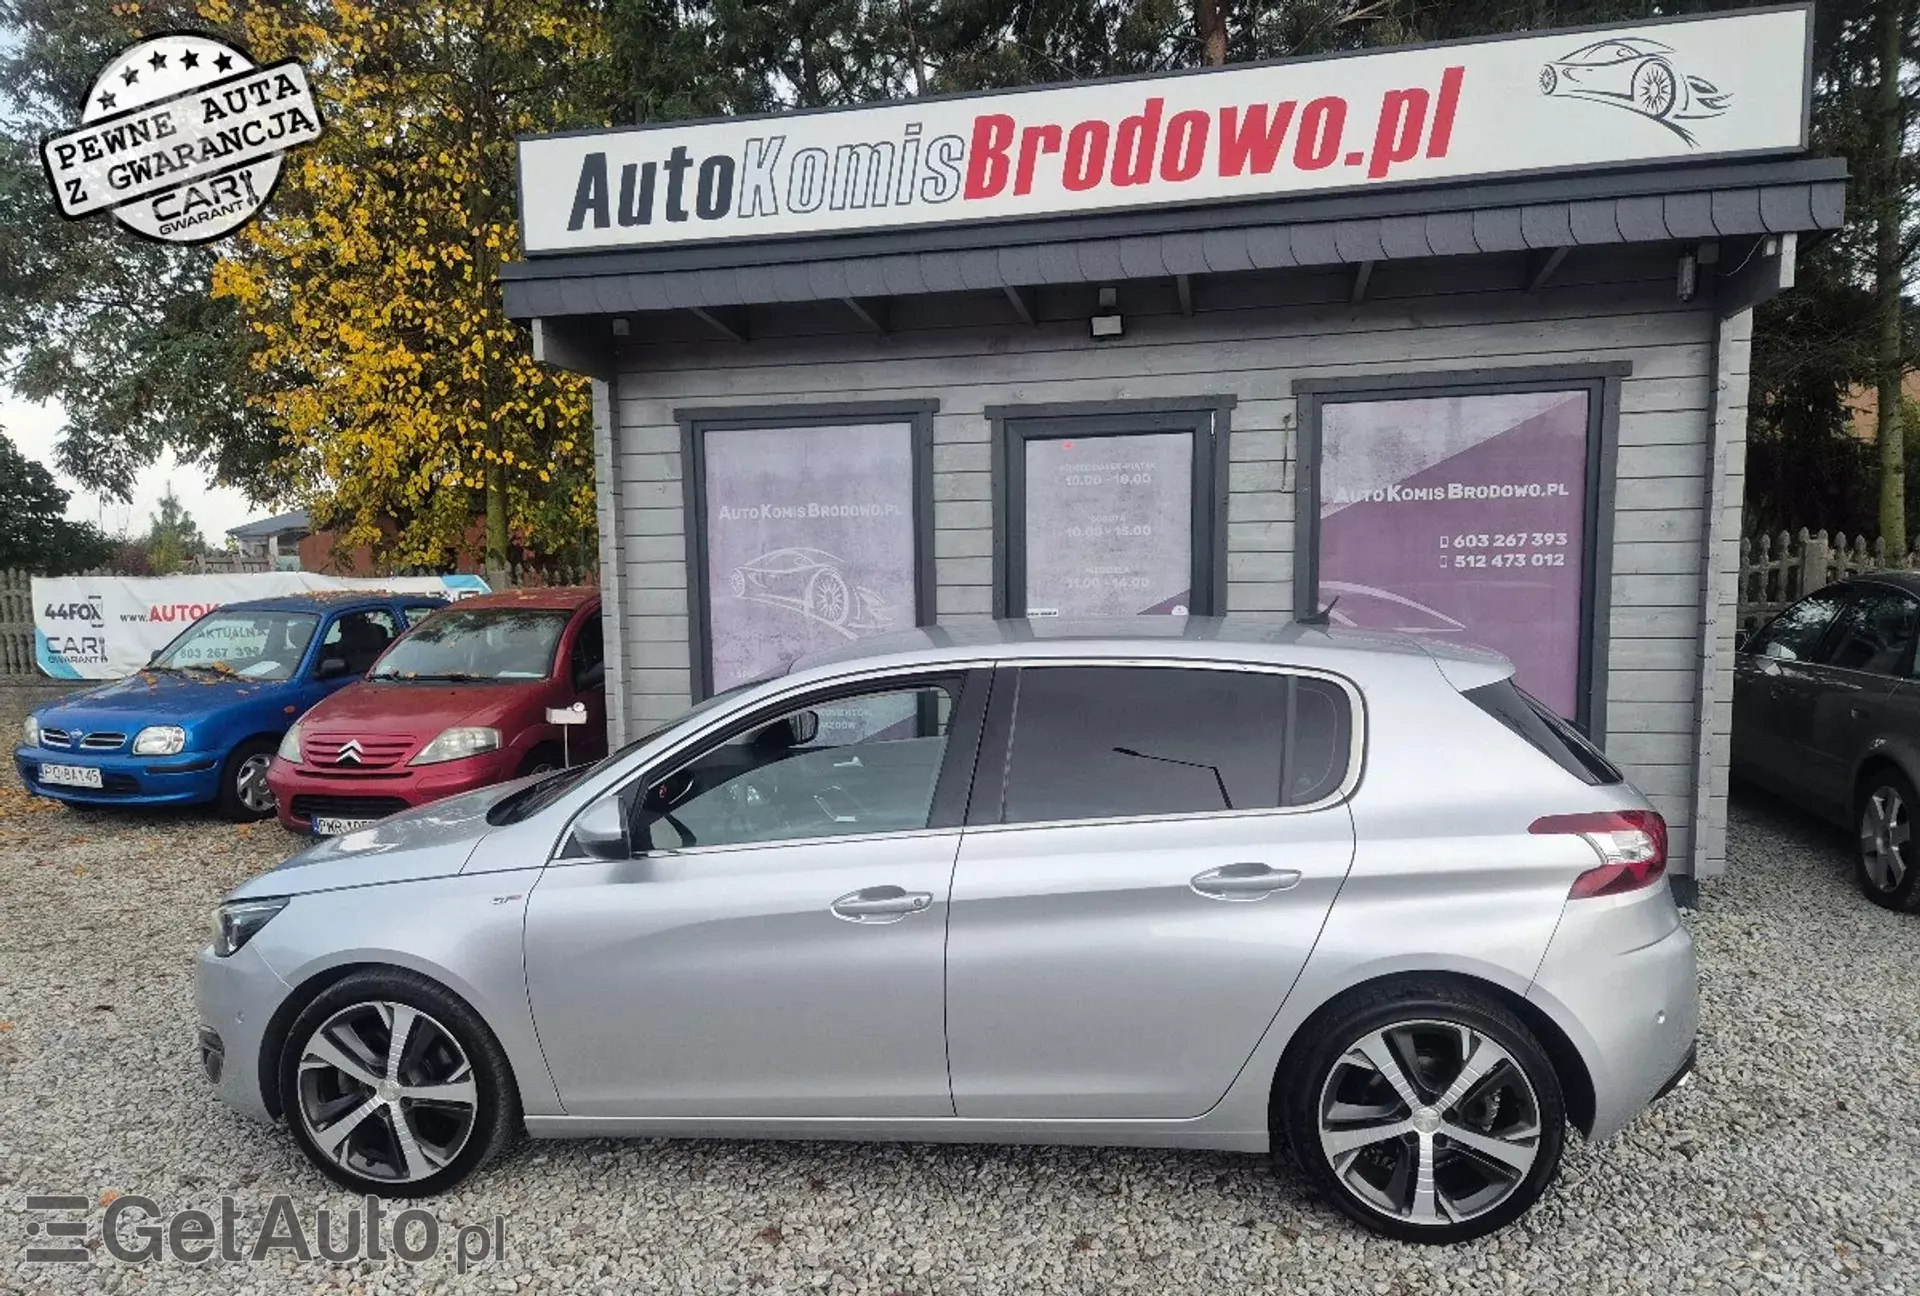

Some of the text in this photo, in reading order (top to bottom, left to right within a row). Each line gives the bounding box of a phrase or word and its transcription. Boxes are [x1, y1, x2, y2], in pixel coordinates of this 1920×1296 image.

[566, 66, 1465, 231] AutoKomisBrodowo.pl
[1453, 533, 1568, 548] 603 267 393
[1454, 553, 1565, 568] 512 473 012
[44, 602, 102, 621] 44FOX
[206, 647, 229, 659] 267
